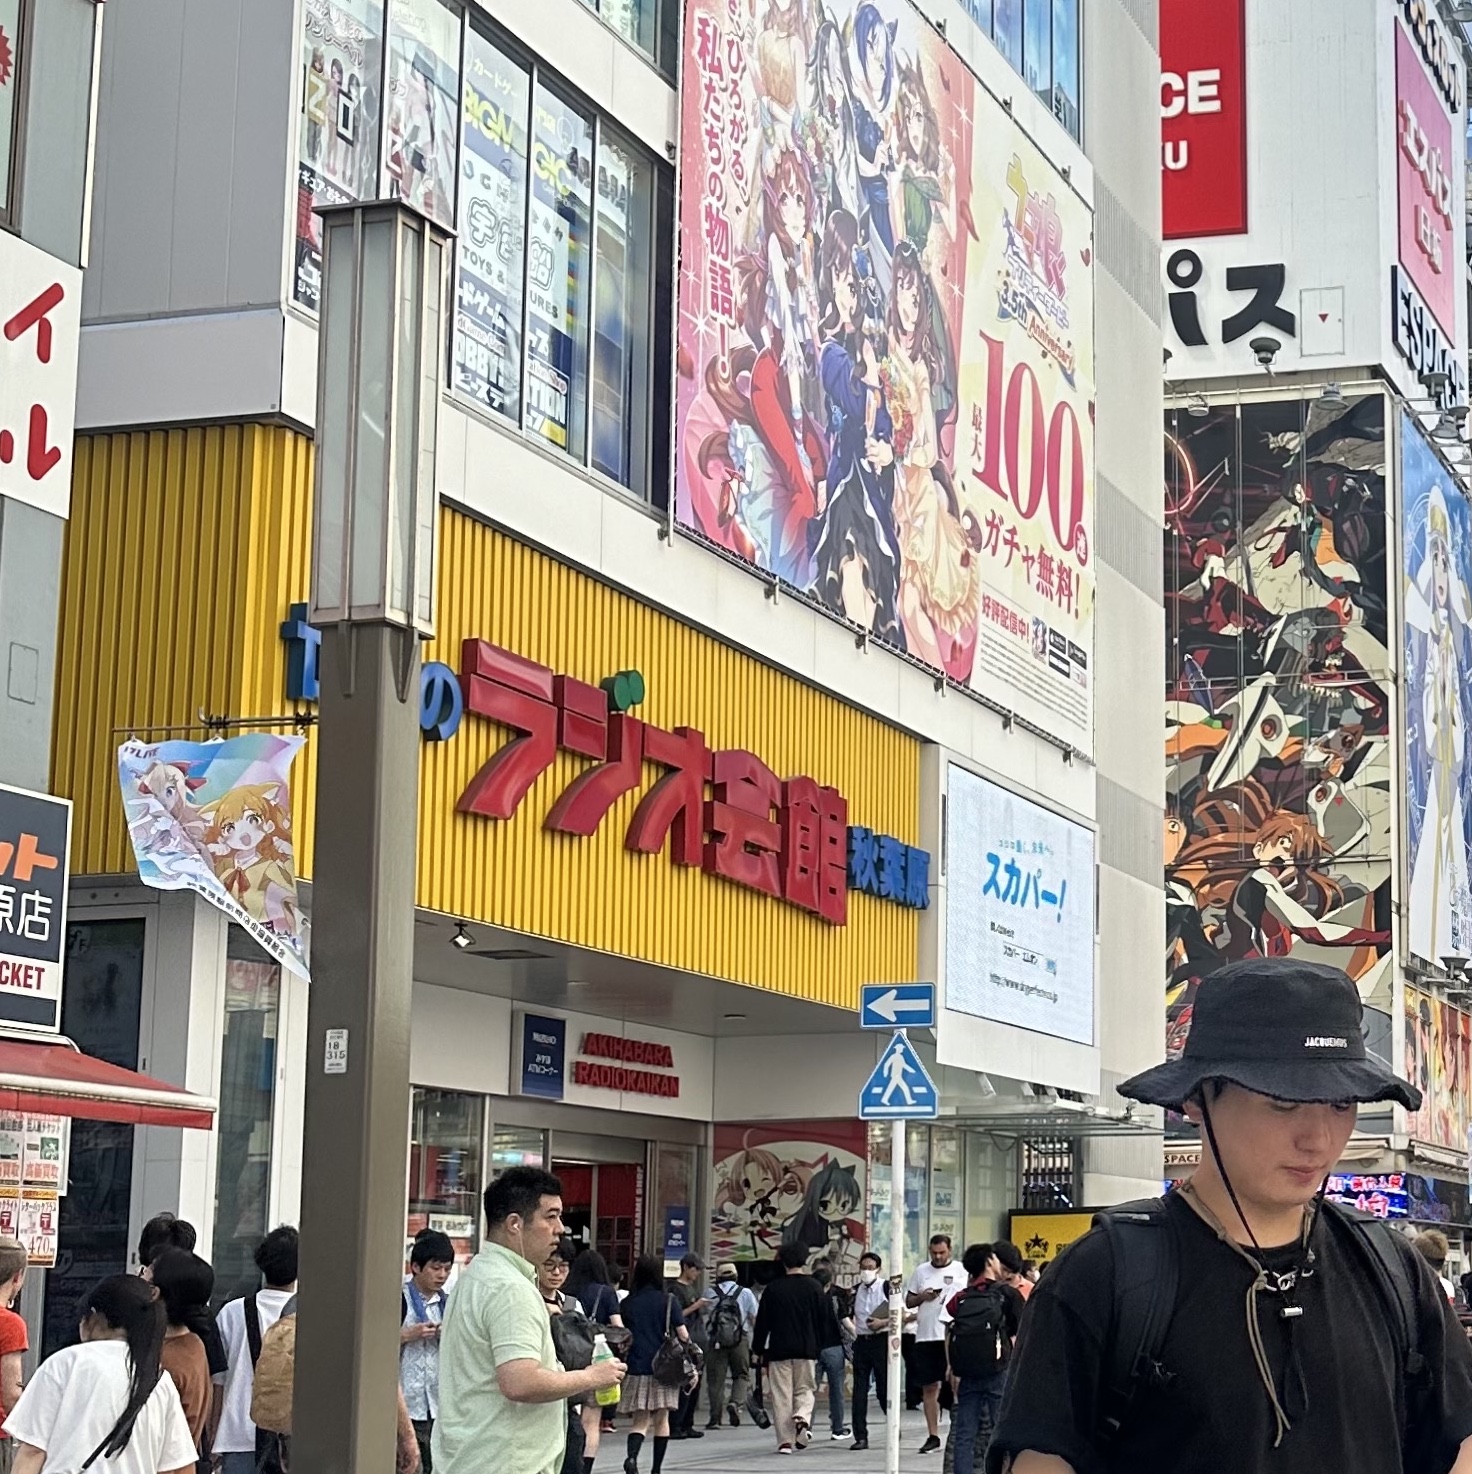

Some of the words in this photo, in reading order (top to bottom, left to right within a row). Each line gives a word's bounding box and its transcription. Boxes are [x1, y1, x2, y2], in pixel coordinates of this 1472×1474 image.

[983, 508, 1081, 620] ガチャ無料!
[457, 637, 848, 928] ラジオ会館
[847, 823, 931, 911] 秋葉原
[982, 851, 1067, 924] スカパー!
[328, 1041, 340, 1050] 18
[582, 1032, 674, 1068] AKIHABARA
[575, 1061, 679, 1098] RADIOKAIKAN
[28, 1236, 50, 1255] 470
